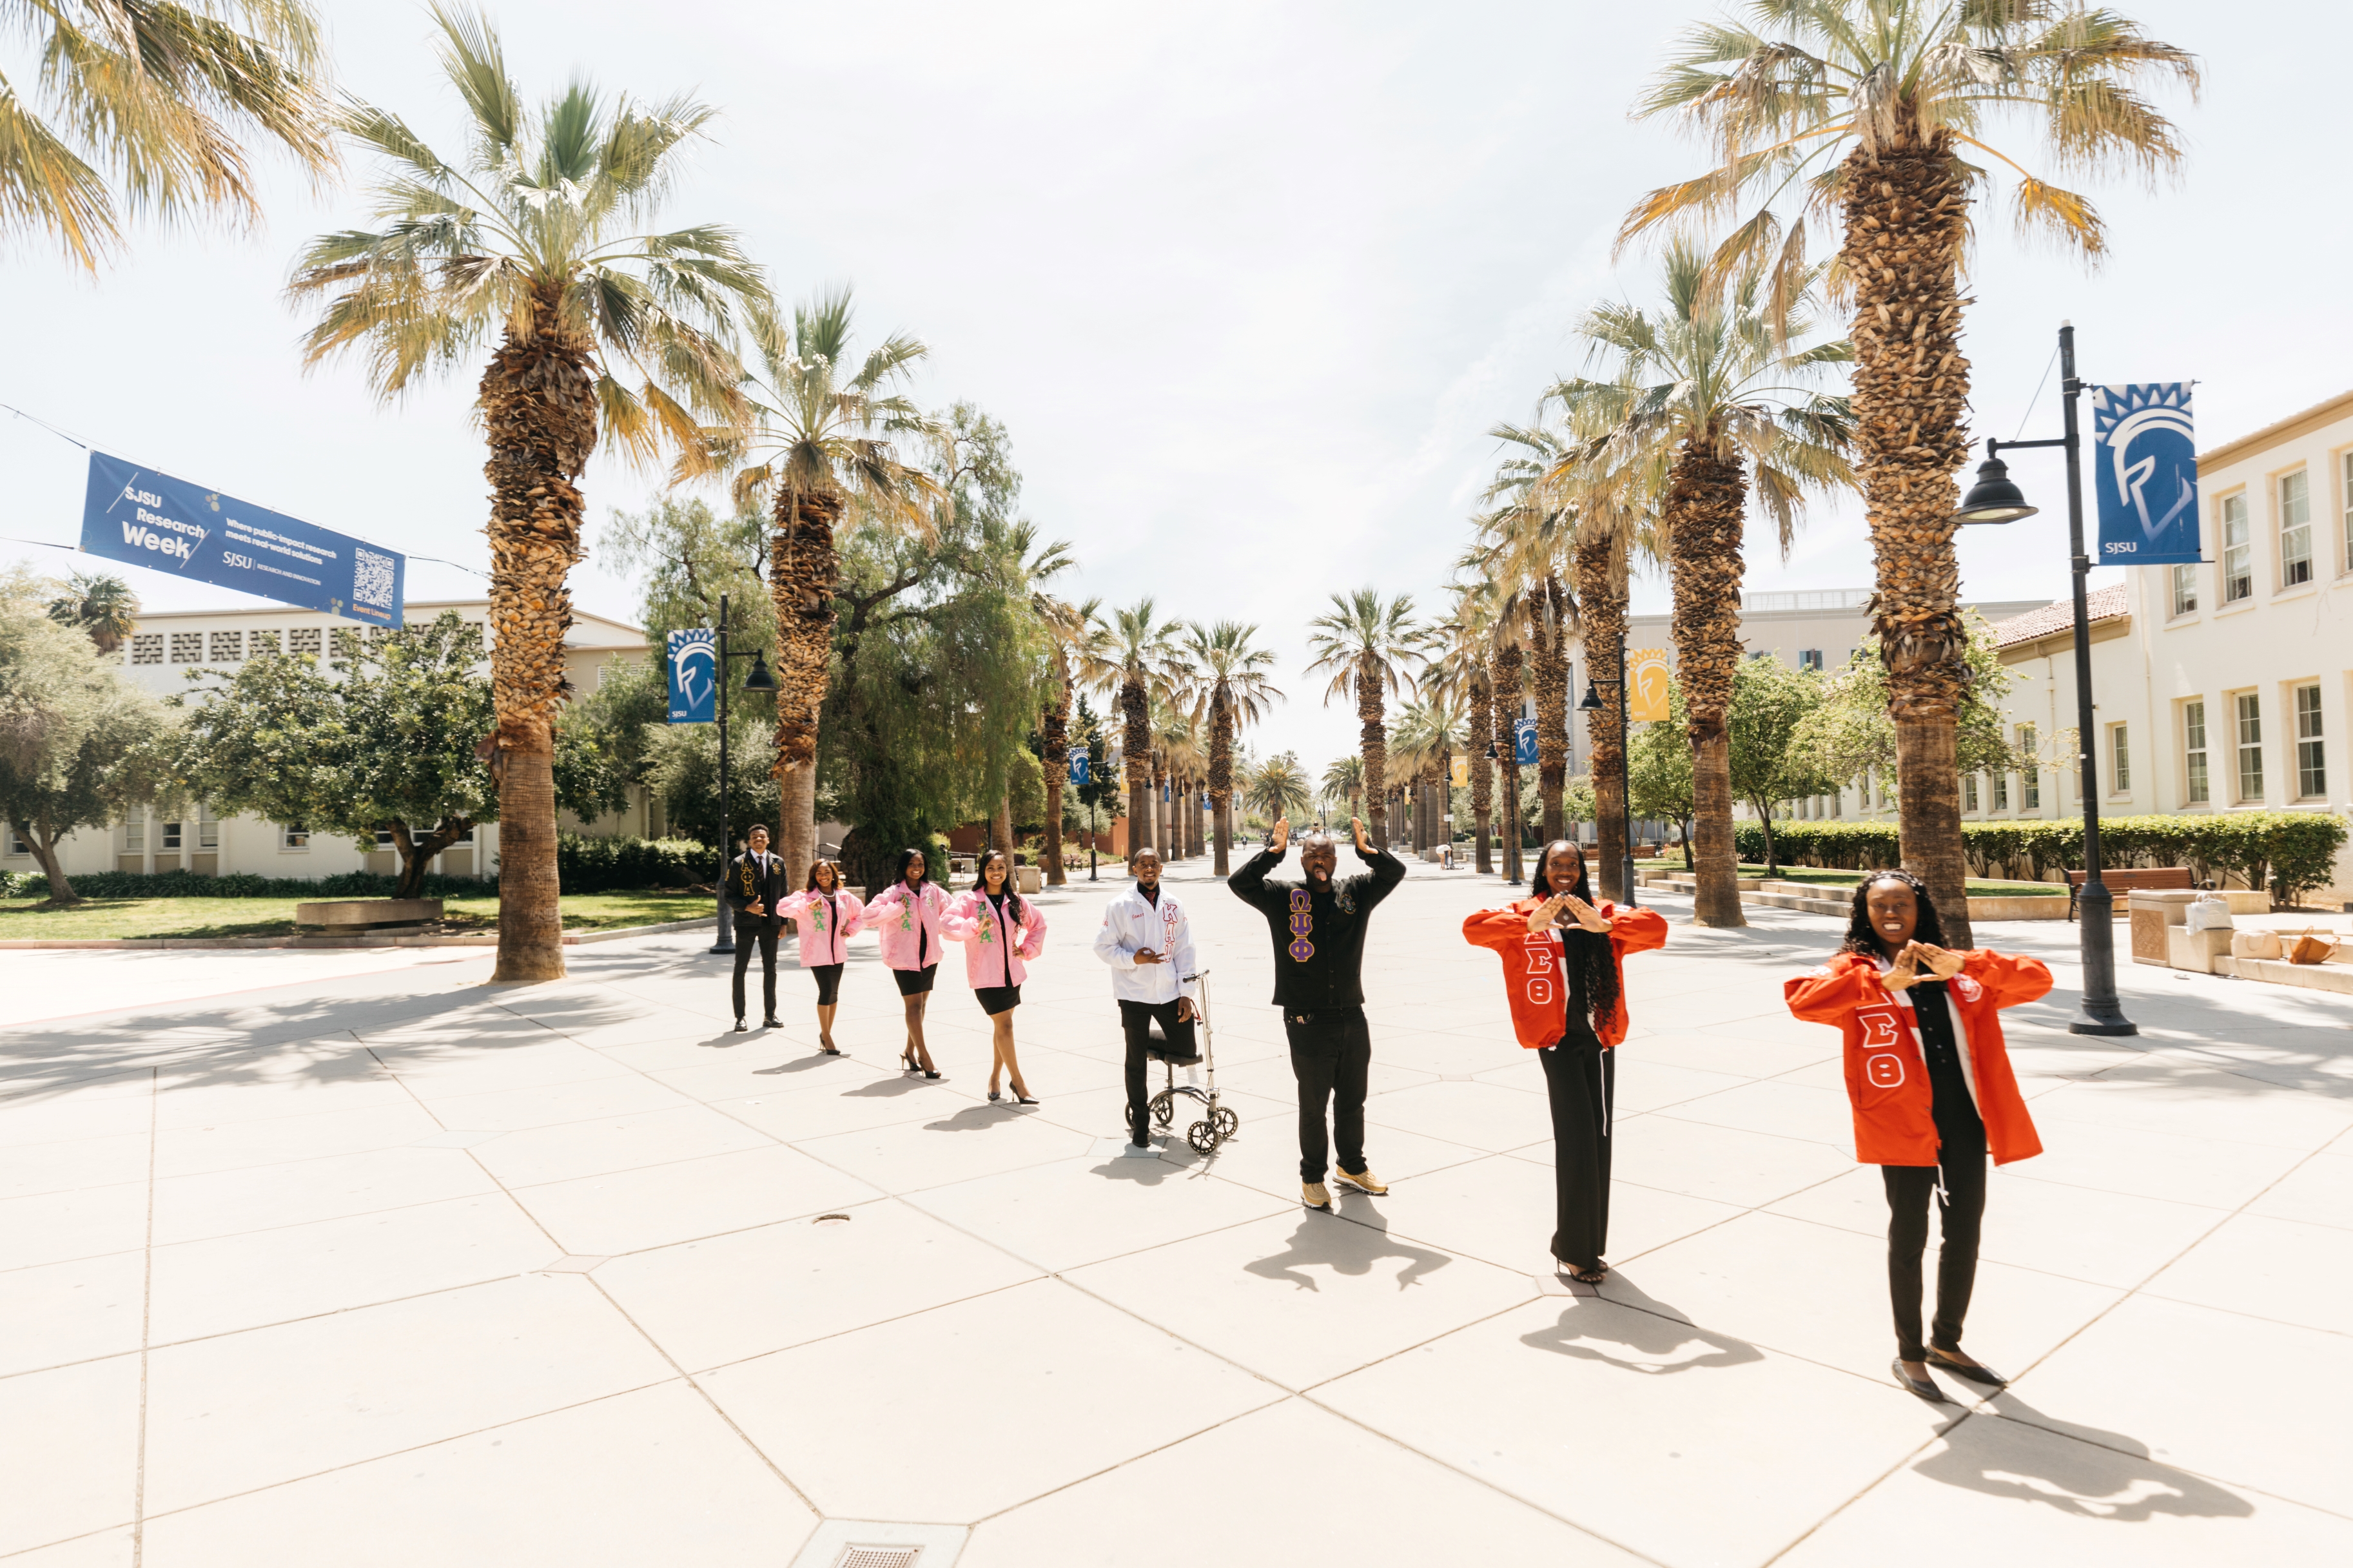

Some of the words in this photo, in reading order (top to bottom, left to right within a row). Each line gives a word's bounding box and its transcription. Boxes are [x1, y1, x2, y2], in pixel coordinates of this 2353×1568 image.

[124, 486, 162, 508] SJSU
[136, 507, 206, 539] Research
[226, 517, 253, 533] Where
[253, 527, 305, 550] public-impact
[305, 544, 337, 559] research
[122, 521, 191, 559] Week
[225, 530, 252, 544] meets
[252, 538, 291, 556] real-world
[291, 550, 323, 565] solutions
[2105, 541, 2138, 555] SJSU
[222, 551, 253, 569] SJSU
[257, 563, 282, 575] RESEARCH
[292, 573, 322, 586] INNOVATION
[353, 603, 371, 615] Event
[371, 608, 391, 620] Lineup
[672, 710, 687, 719] SJSU
[1289, 888, 1315, 963] ΩΨΦ
